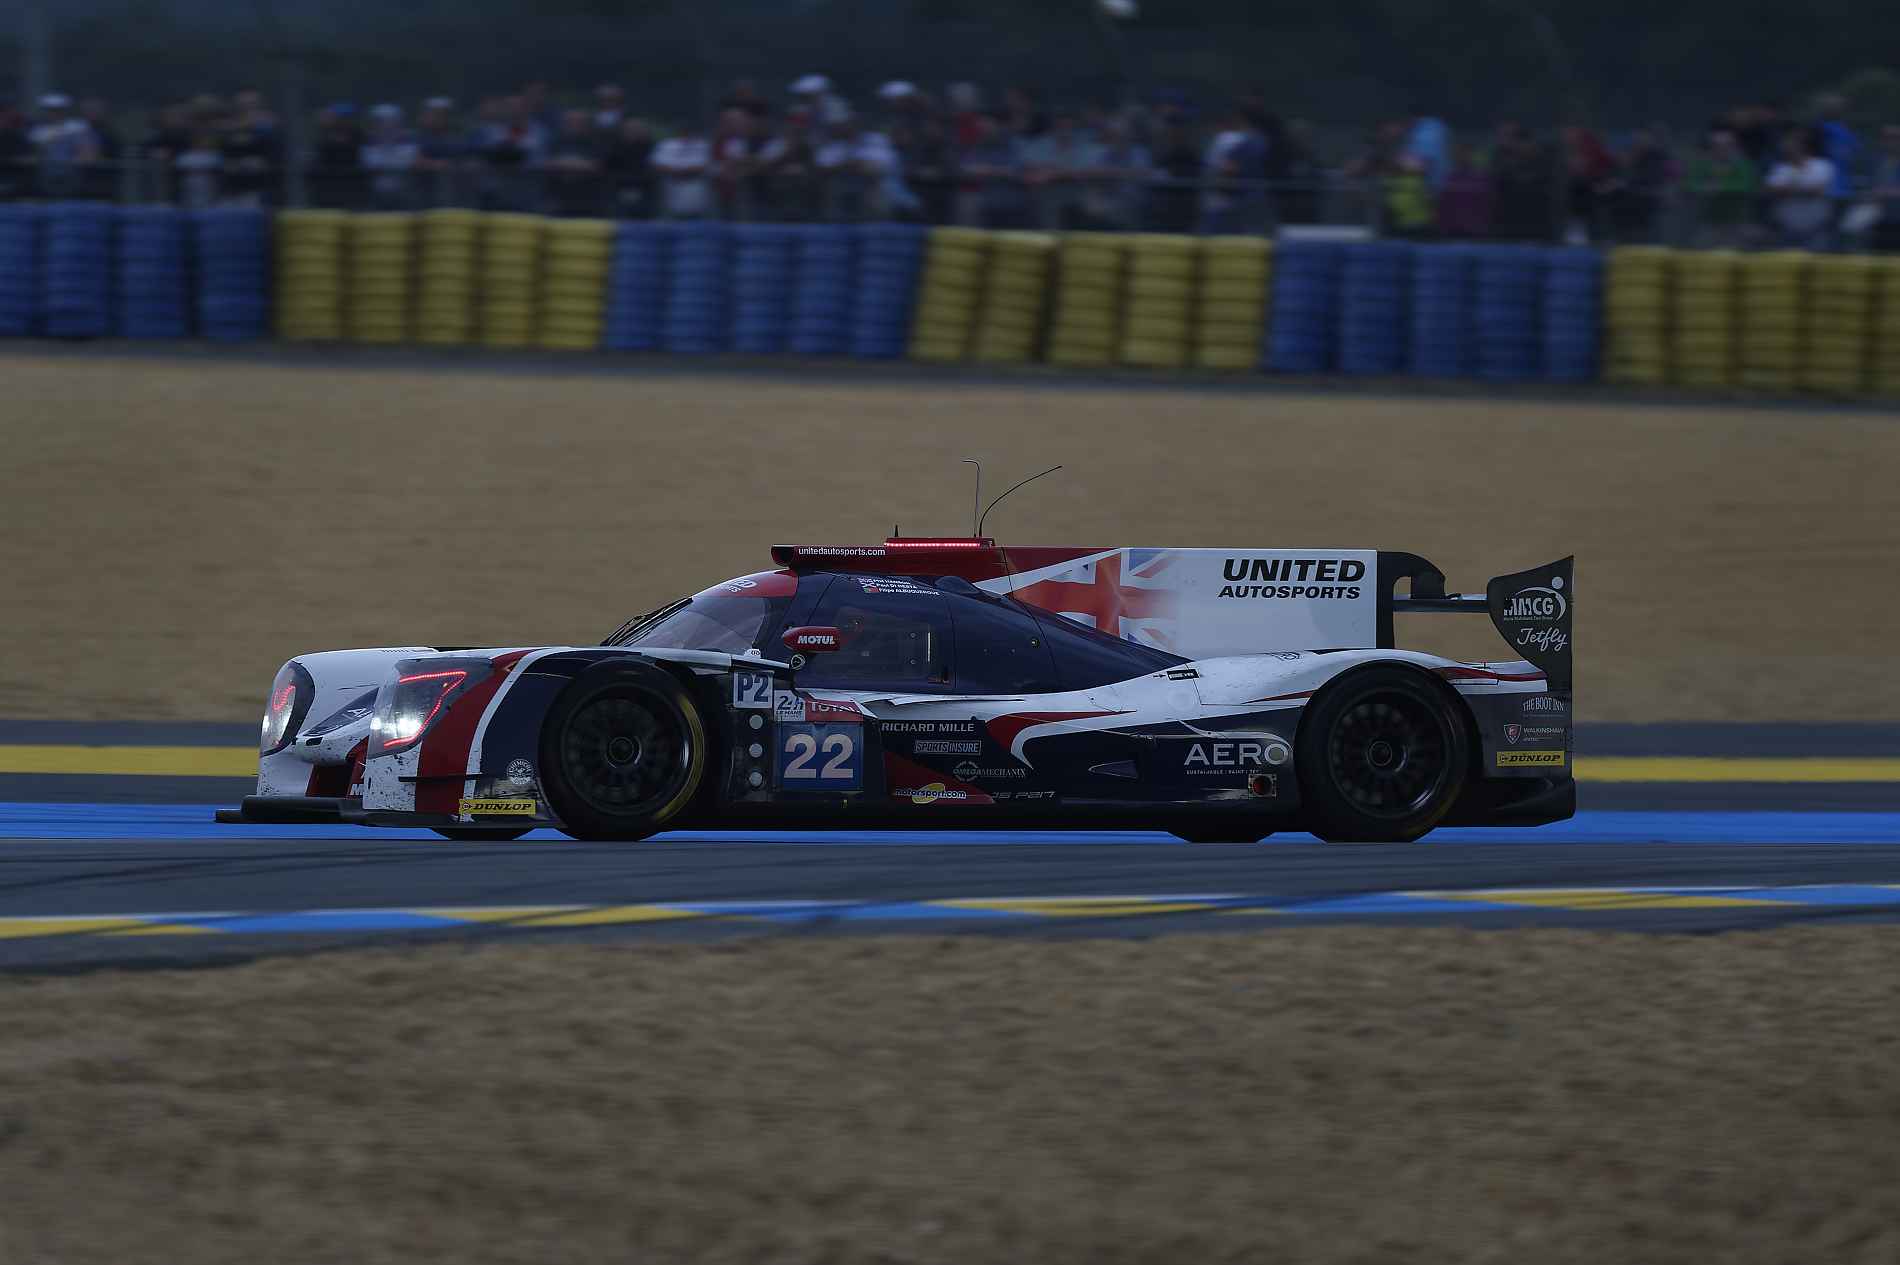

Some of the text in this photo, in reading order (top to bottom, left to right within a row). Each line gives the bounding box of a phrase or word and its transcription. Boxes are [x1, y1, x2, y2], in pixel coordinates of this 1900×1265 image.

[798, 547, 886, 557] unitedautosports.com
[1223, 558, 1366, 582] UNITED
[1217, 585, 1361, 599] AUTOSPORTS
[797, 635, 836, 645] MOTUL
[1517, 626, 1568, 652] Jetfly
[737, 672, 769, 702] P2
[881, 722, 975, 732] RICHARD MILLE
[783, 733, 854, 779] 22
[1184, 743, 1289, 765] AERO
[895, 788, 967, 800] motorsport.com
[472, 803, 532, 811] DUNLOP
